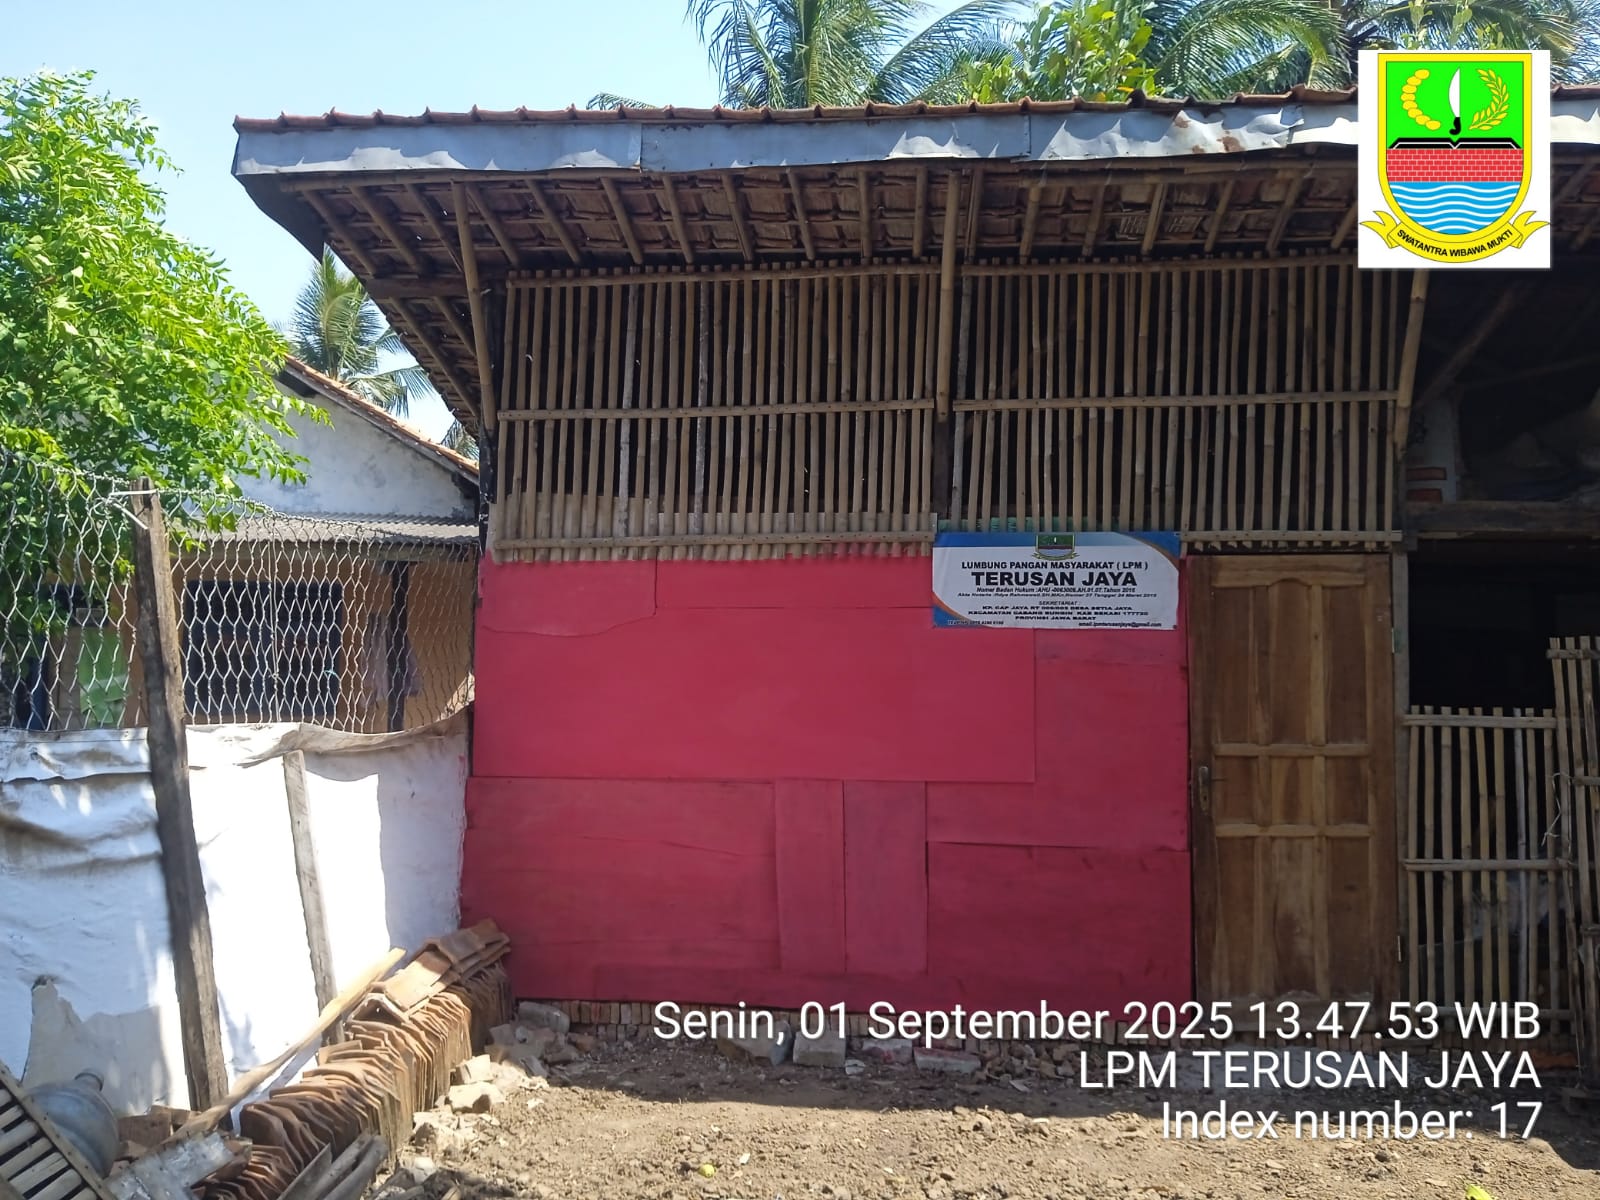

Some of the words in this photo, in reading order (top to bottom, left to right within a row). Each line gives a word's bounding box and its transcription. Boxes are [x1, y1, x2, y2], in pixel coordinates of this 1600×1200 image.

[961, 561, 1007, 569] LUMBUNG
[1009, 561, 1048, 569] PANGAN
[1050, 561, 1114, 569] MASYARAKAT
[971, 572, 1075, 586] TERUSAN
[1081, 572, 1137, 586] JAYA
